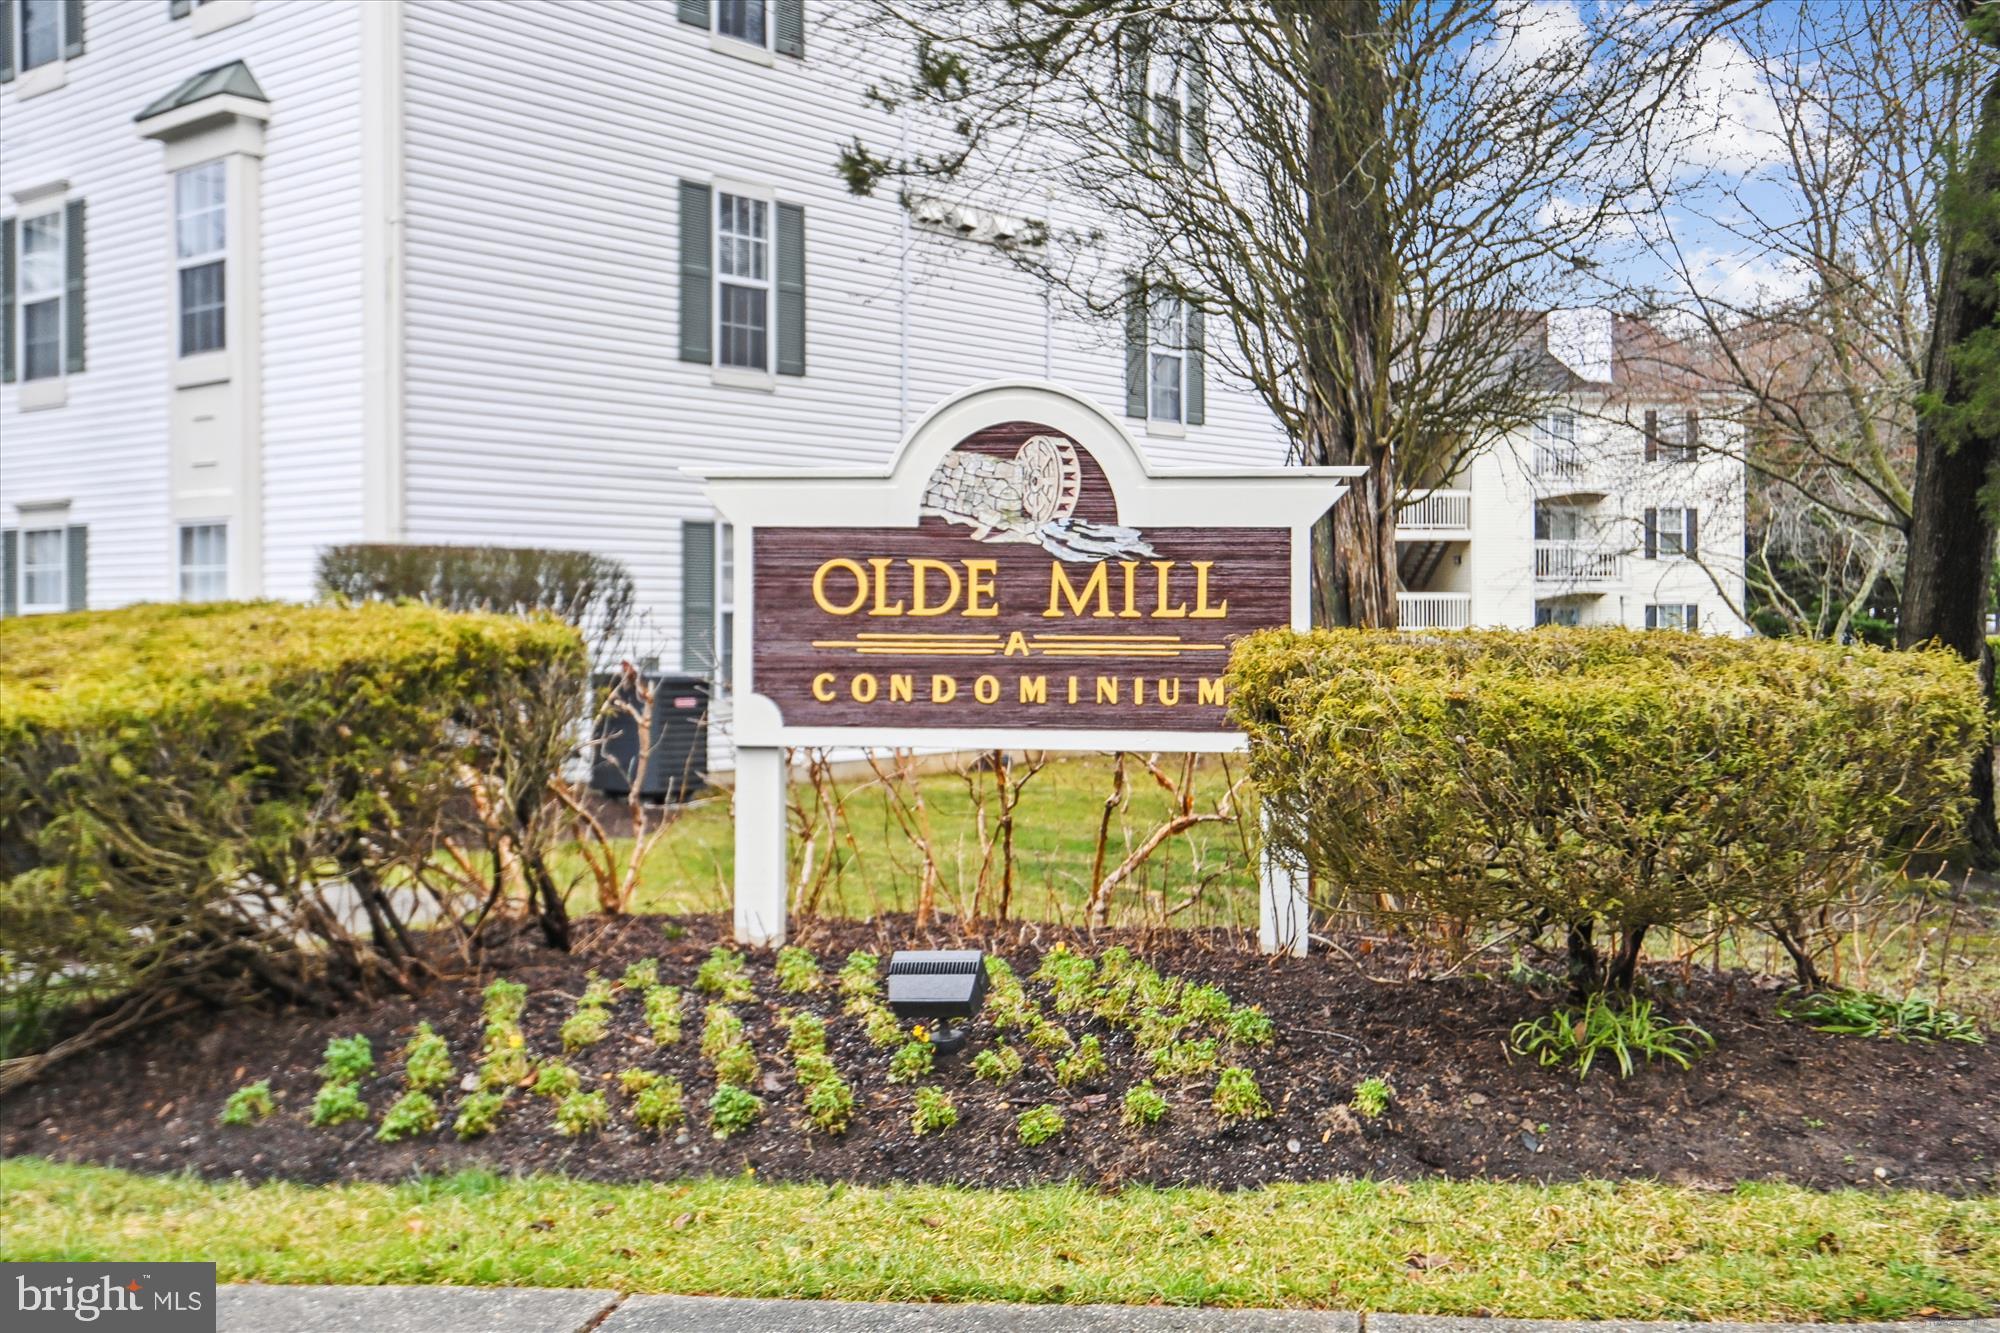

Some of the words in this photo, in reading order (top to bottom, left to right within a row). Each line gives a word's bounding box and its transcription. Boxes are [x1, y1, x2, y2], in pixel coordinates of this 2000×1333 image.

[812, 557, 1000, 617] OLDE
[1042, 559, 1228, 618] MILL
[1003, 631, 1030, 657] A
[811, 672, 1226, 707] CONDOMINIUM
